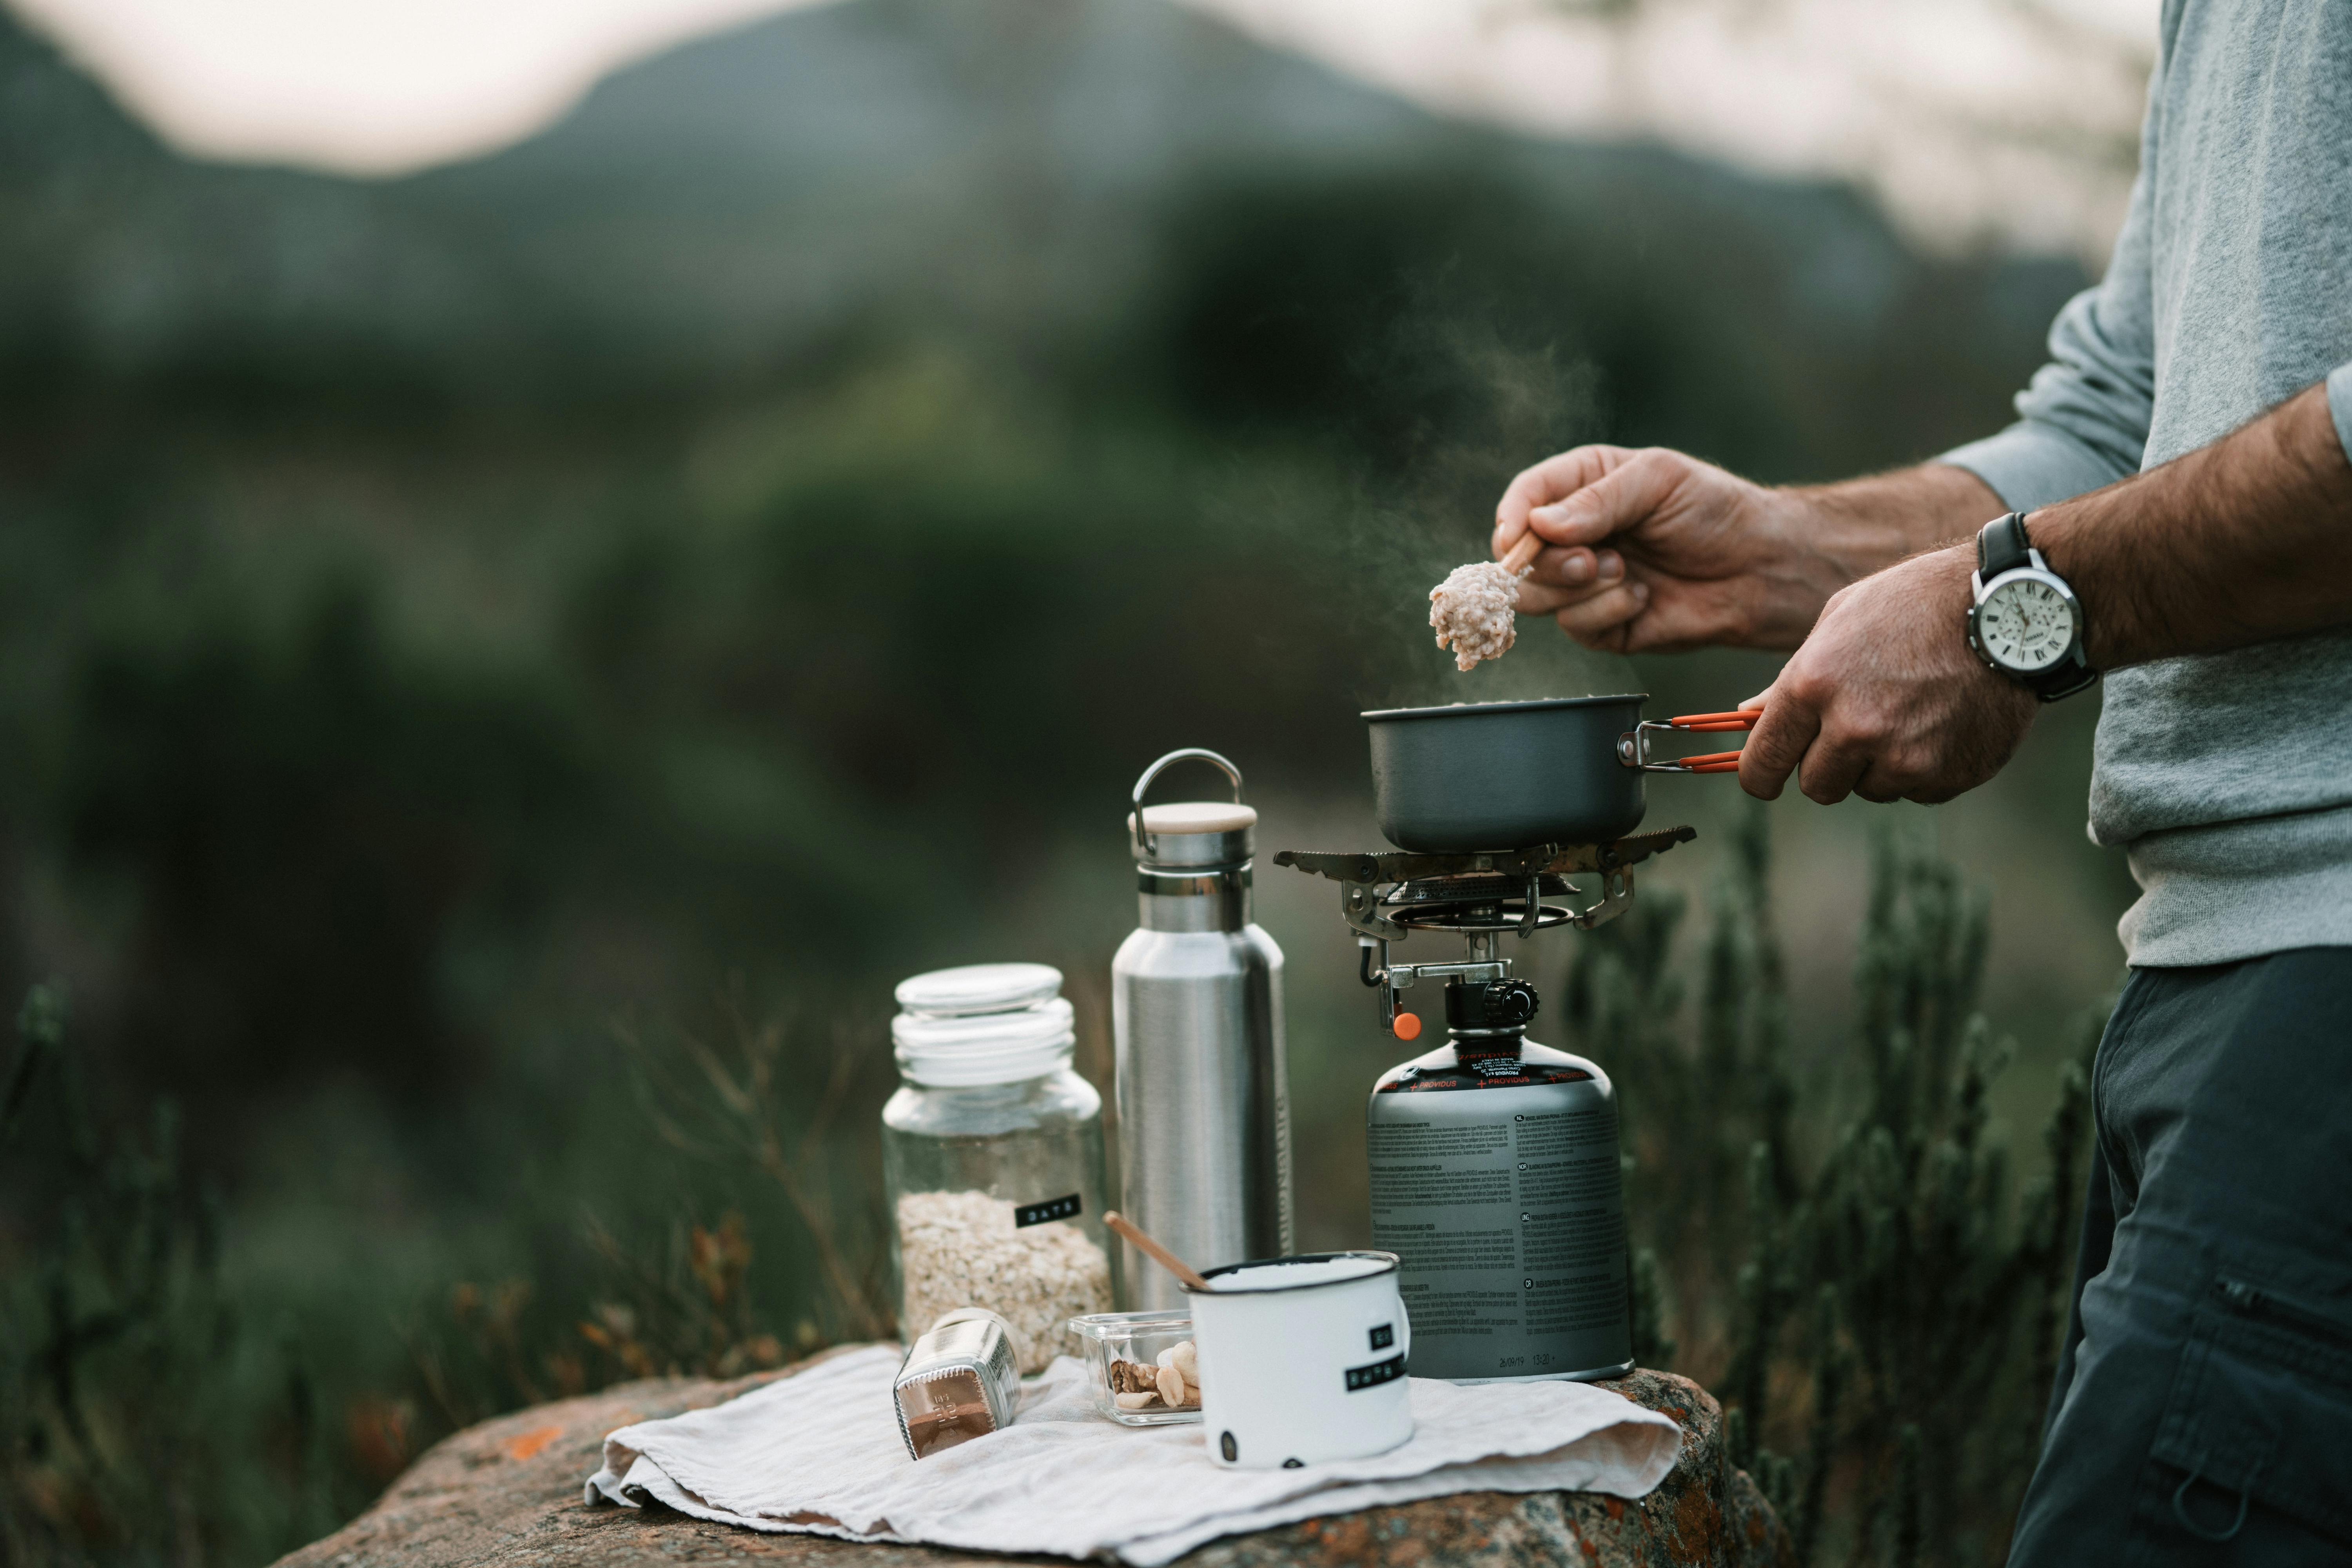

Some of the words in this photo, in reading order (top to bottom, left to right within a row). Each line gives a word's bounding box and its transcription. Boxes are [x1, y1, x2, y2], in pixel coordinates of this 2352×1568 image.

[1556, 1071, 1587, 1079] PROVIDUS
[1419, 1080, 1457, 1089] PROVIDUS
[1499, 1356, 1524, 1368] 26/09/19
[1533, 1354, 1550, 1365] 13:20
